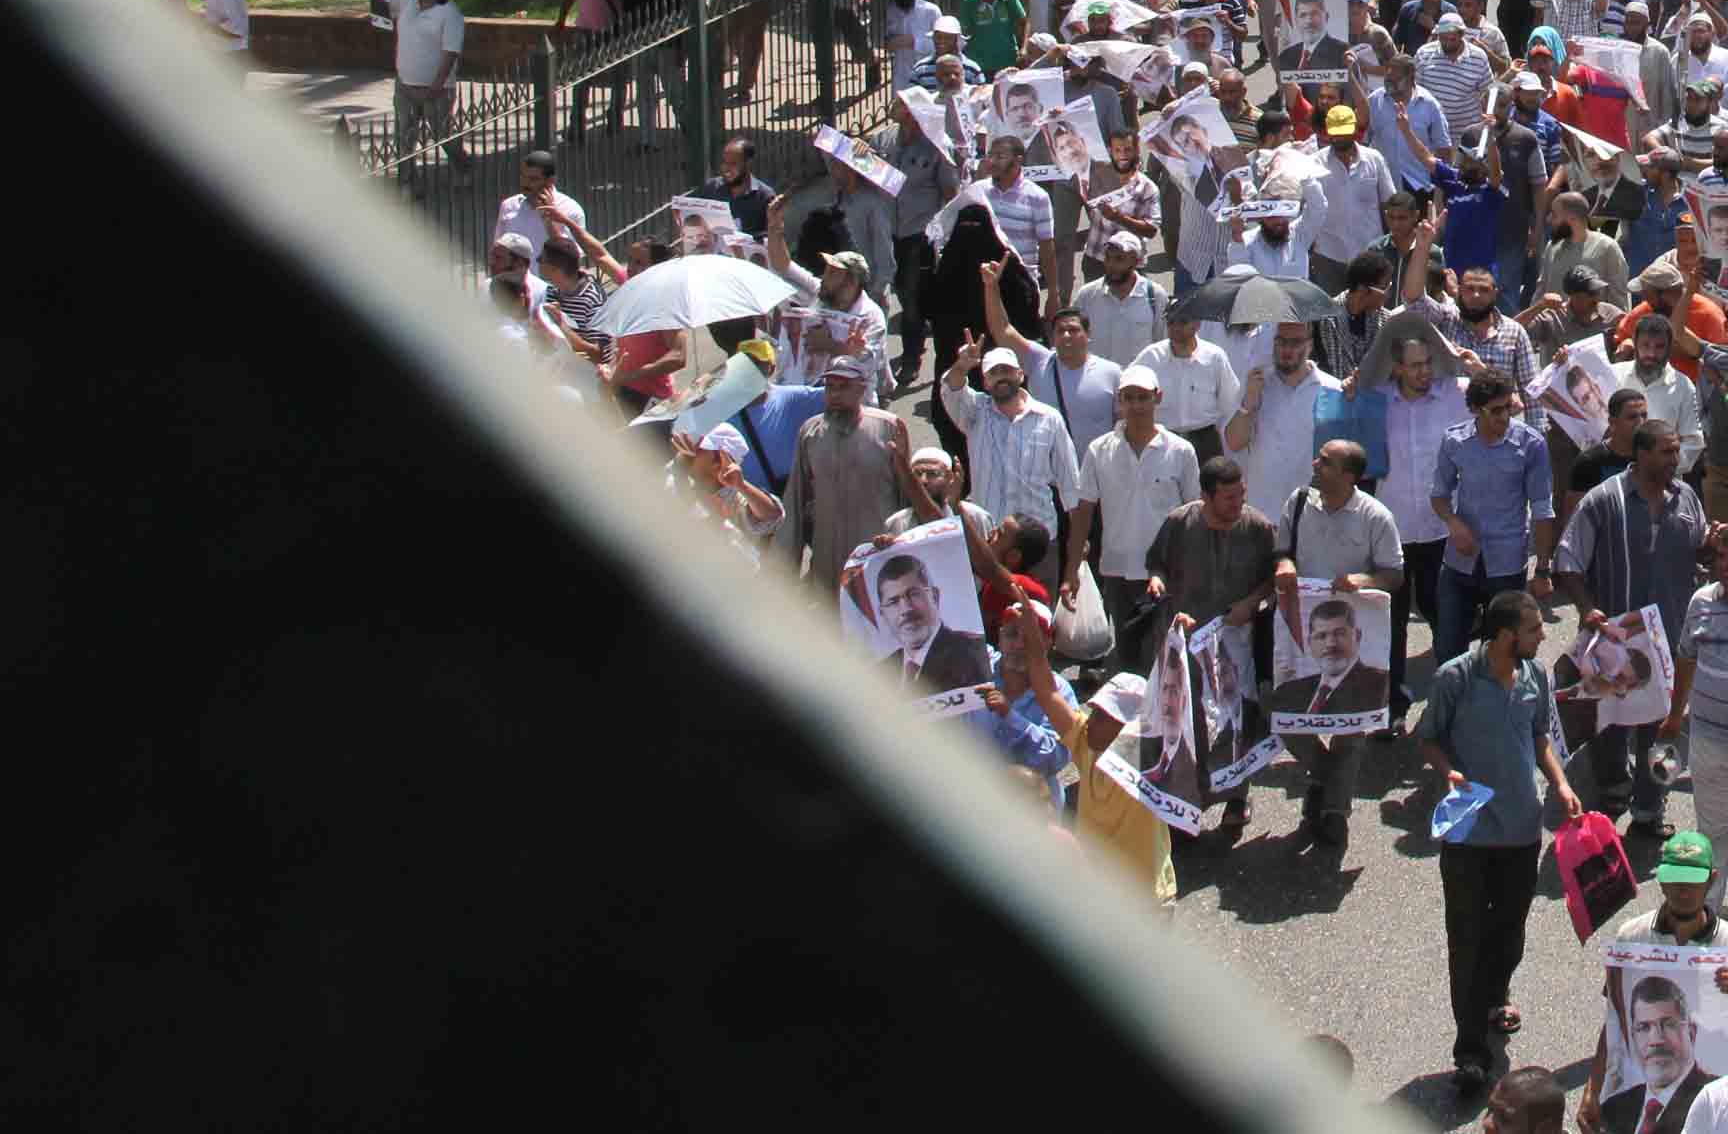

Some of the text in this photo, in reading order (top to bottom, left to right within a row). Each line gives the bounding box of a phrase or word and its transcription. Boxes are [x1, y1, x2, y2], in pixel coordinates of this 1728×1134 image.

[1277, 713, 1384, 729] لا للانقلاب
[1607, 945, 1728, 966] نعم للشرعية
